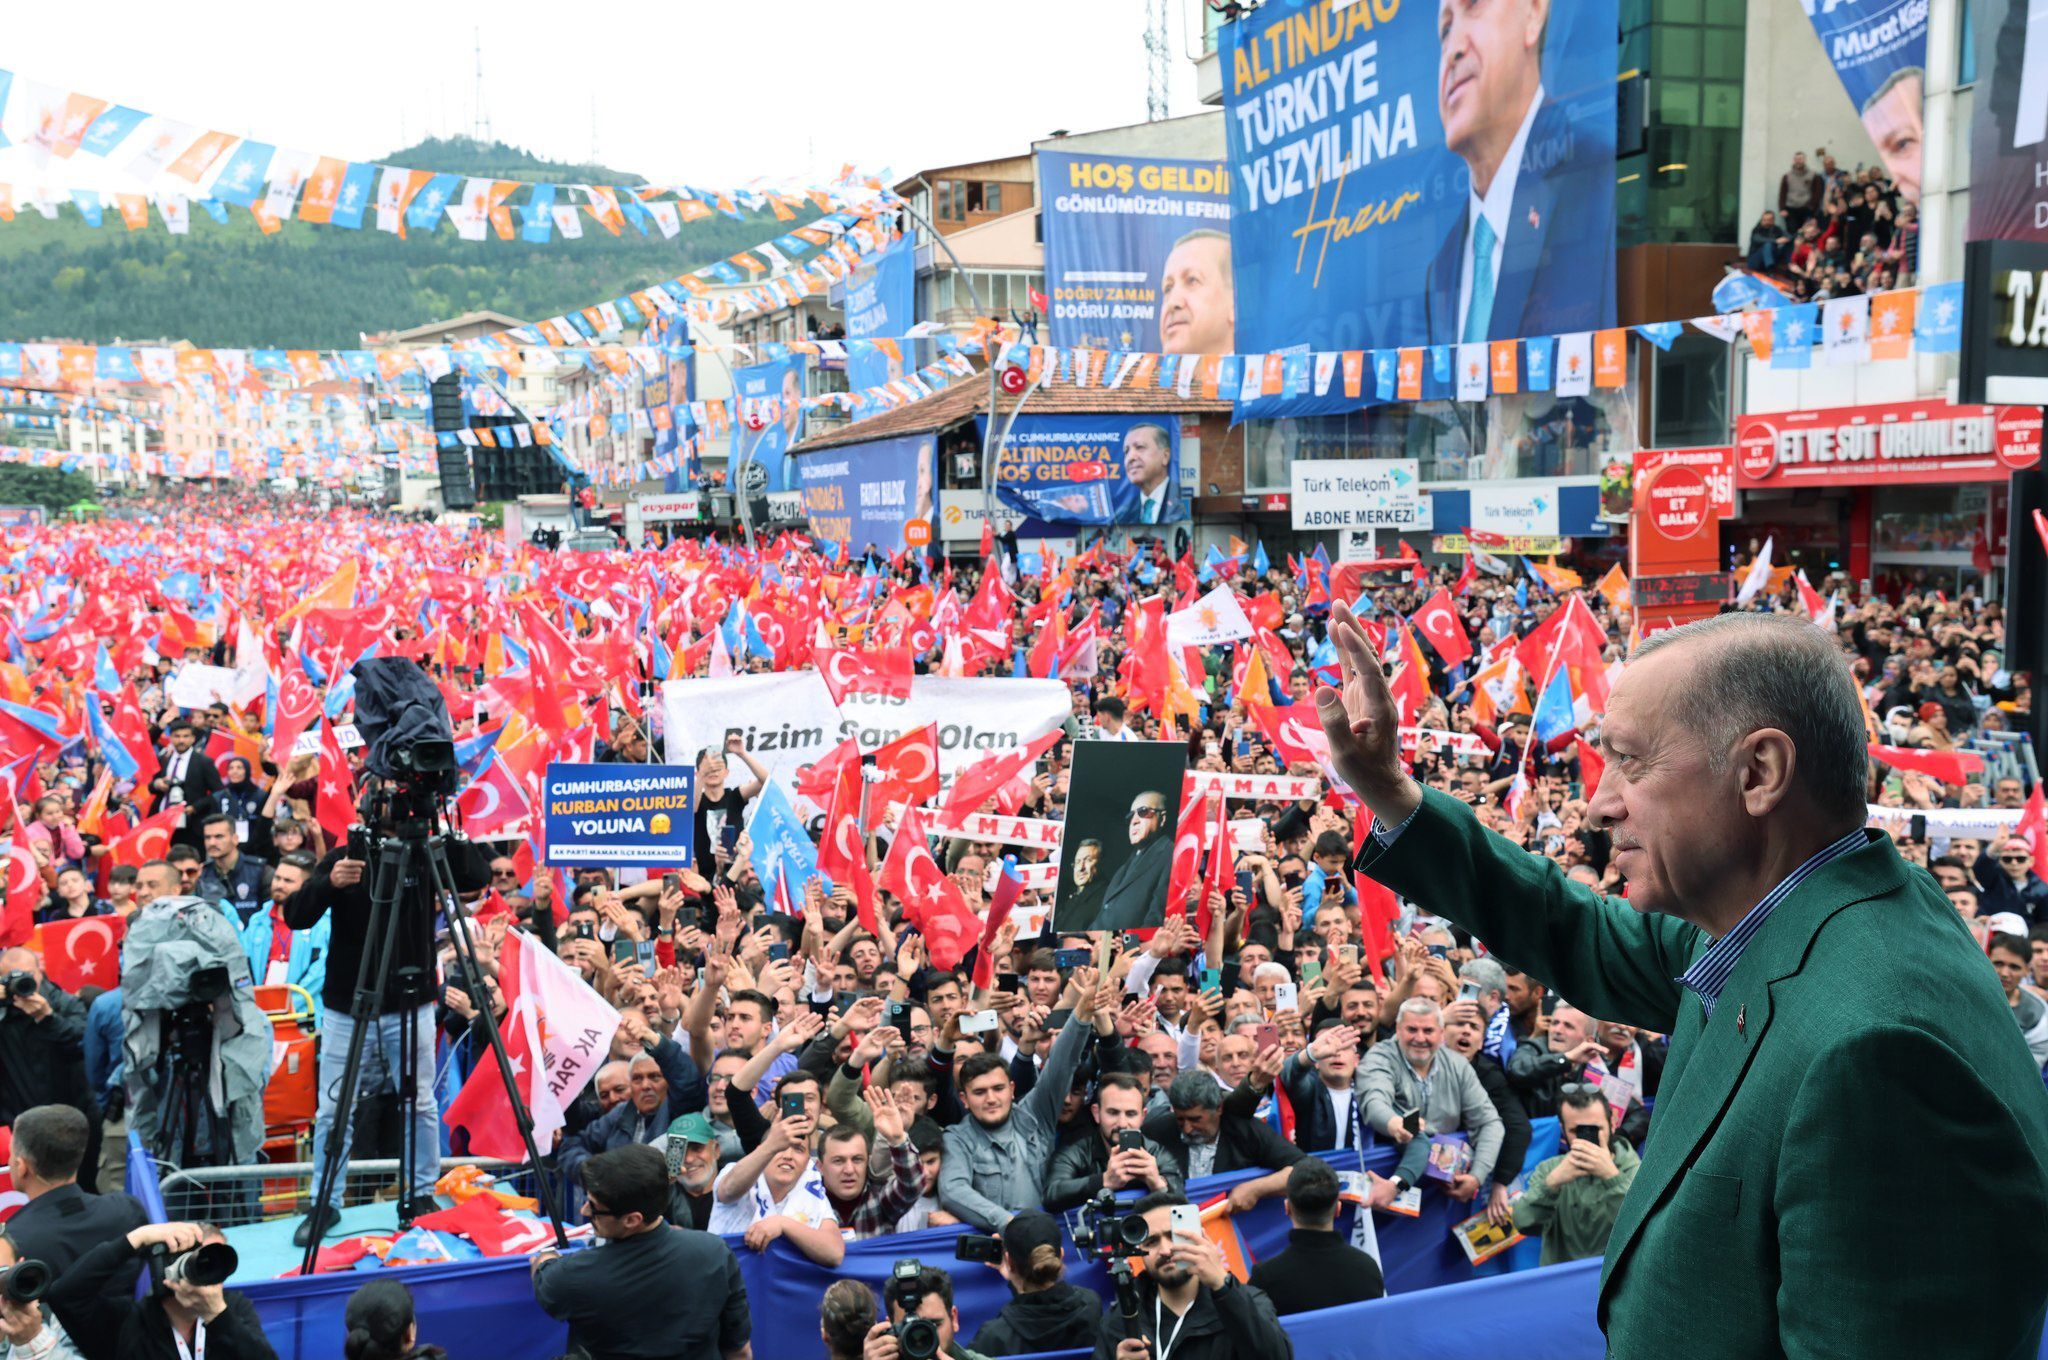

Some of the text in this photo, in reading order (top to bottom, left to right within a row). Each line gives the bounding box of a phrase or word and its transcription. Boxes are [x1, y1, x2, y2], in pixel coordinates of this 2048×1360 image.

[1833, 15, 1900, 60] Murat
[1236, 40, 1379, 153] TÜRKİYE
[1240, 93, 1418, 212] YÜZYILINA
[1070, 163, 1134, 194] HOŞ
[1055, 194, 1183, 217] GÖNLÜMÜZÜN
[1054, 286, 1155, 302] DOĞRU ZAMAN
[1055, 302, 1155, 319] DOĞRU ADAM
[1020, 432, 1121, 444] CUMHURBAŞKANIMIZ
[1779, 406, 1995, 463] ET VE SÜT ÜRÜNLERİ
[1303, 477, 1390, 492] Türk Telekom
[642, 501, 695, 514] evyapar
[1484, 506, 1535, 517] Türk Telekom
[1669, 498, 1687, 511] ET
[1304, 510, 1351, 525] ABONE
[1658, 513, 1699, 527] BALIK
[836, 719, 901, 746] San
[938, 725, 1018, 750] Olan
[551, 776, 688, 796] CUMHURBAŞKANIM
[1208, 777, 1306, 797] AMAK
[551, 795, 687, 815] KURBAN OLURUZ
[571, 817, 646, 836] YOLUNA
[566, 848, 588, 856] PARTİ
